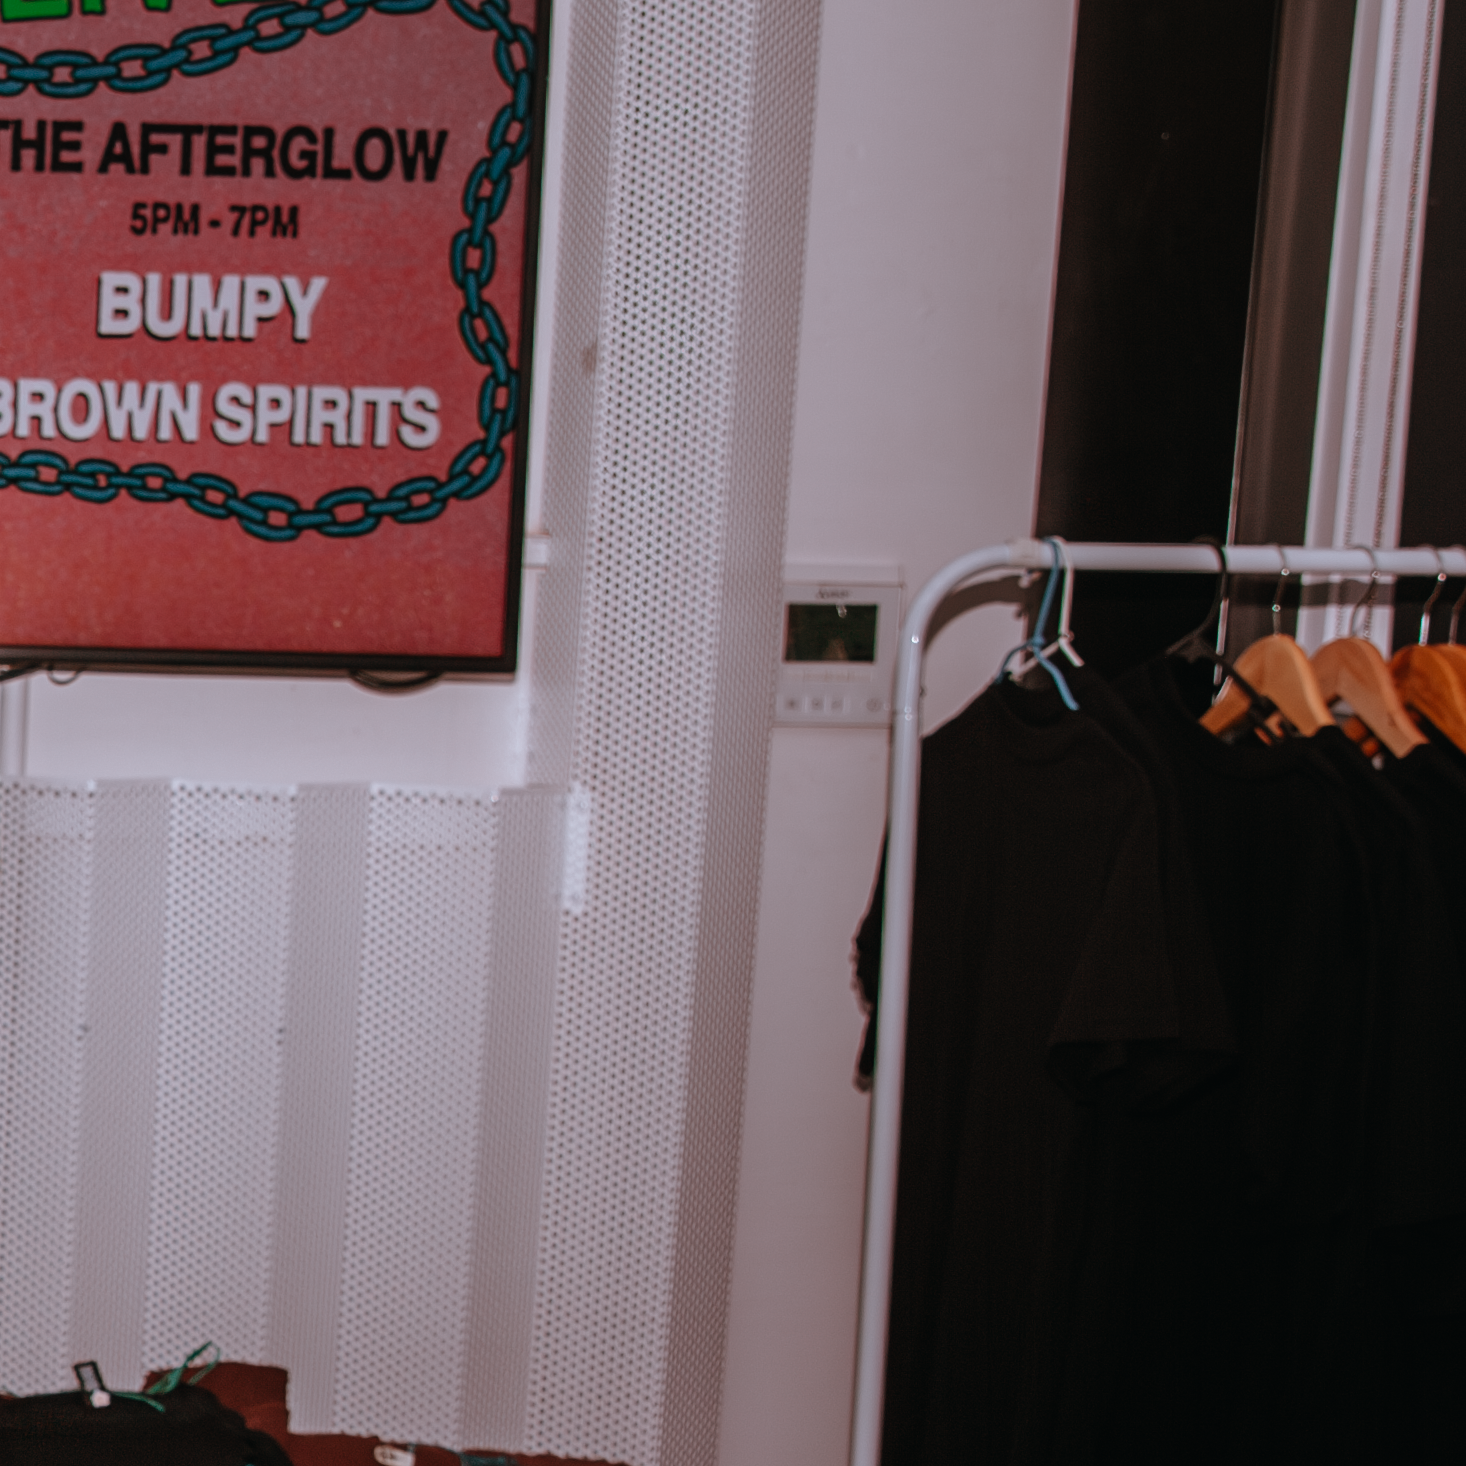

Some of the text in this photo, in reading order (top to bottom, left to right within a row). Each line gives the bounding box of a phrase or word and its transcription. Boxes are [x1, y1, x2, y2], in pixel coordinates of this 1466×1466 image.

[97, 122, 449, 183] AFTERGLOW
[129, 203, 299, 238] 5PM 7PM
[97, 271, 328, 342] BUMPY
[213, 382, 441, 449] SPIRITS
